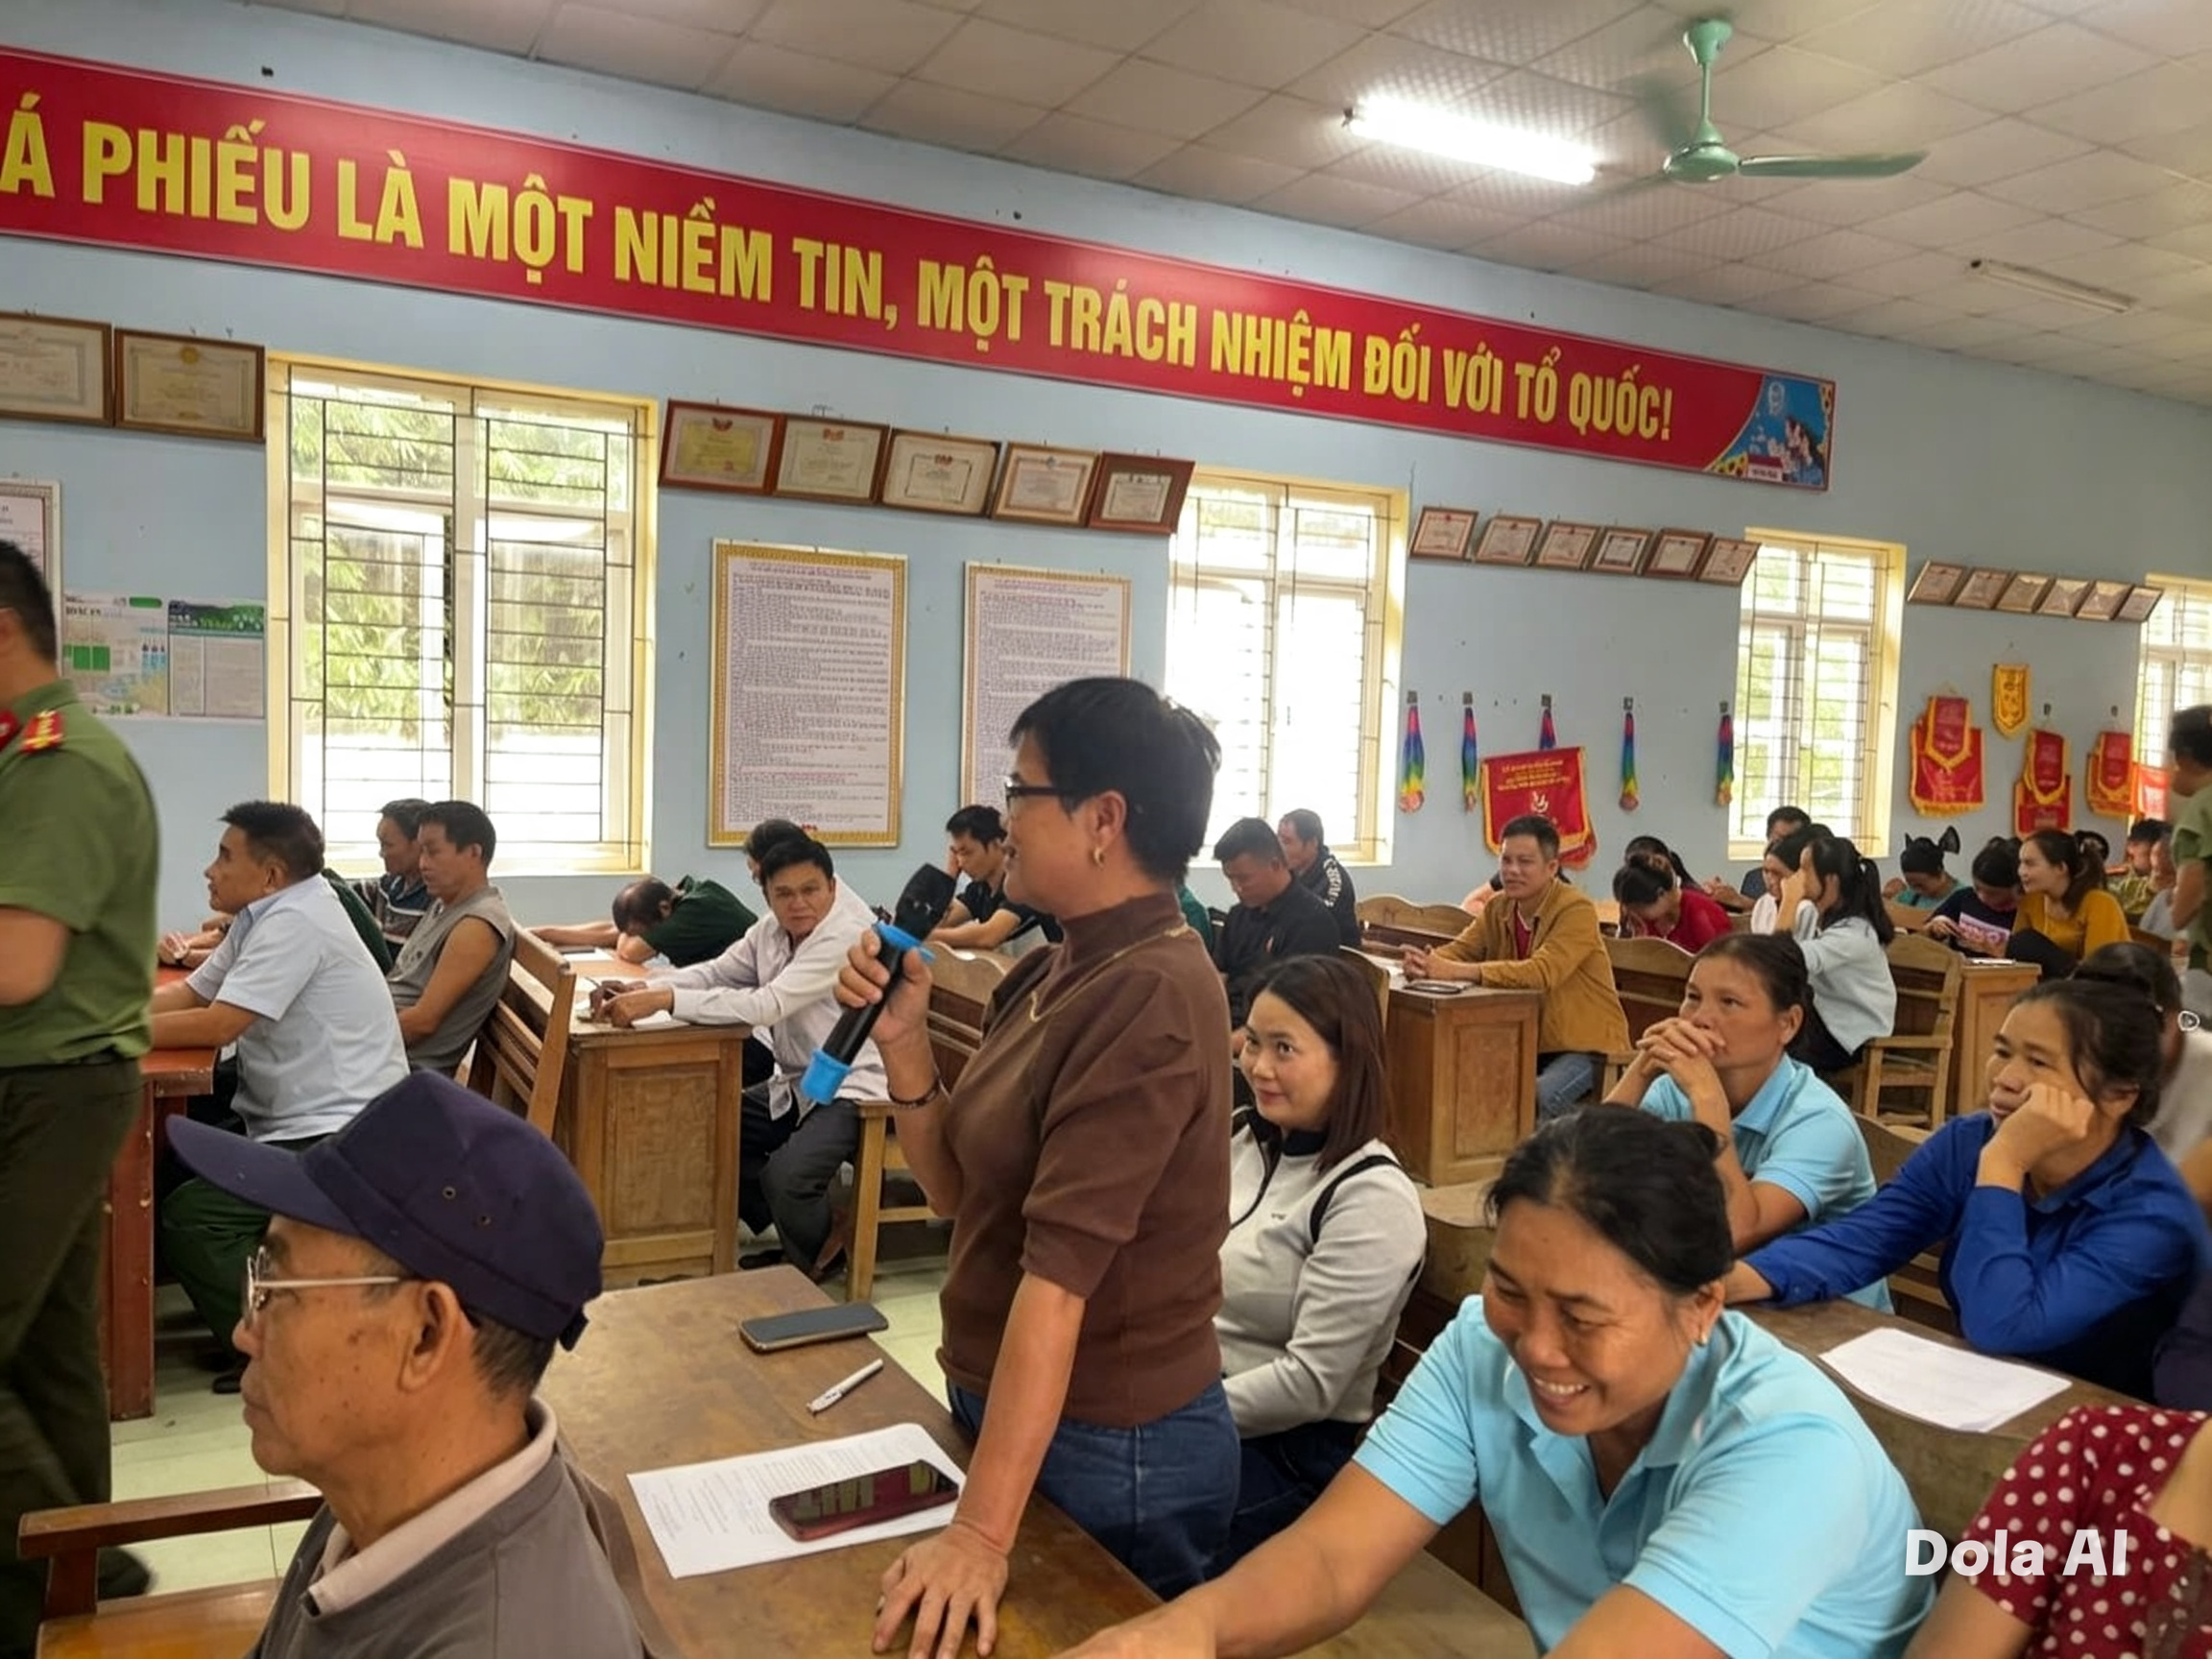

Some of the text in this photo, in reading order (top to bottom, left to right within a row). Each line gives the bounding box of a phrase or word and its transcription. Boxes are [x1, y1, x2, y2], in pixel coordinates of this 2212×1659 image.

[83, 119, 311, 231] PHIẾU
[337, 149, 423, 250] LÀ
[448, 173, 593, 284] MỘT
[614, 196, 773, 302] NIỀM
[793, 237, 898, 330] TIN,
[918, 254, 1028, 351] MỘT
[1045, 278, 1197, 368] TRÁCH
[1212, 309, 1351, 397] NHIỆM
[1363, 322, 1431, 402] ĐỐI
[1443, 343, 1503, 415] VỚI
[1514, 346, 1561, 423] TỔ
[1568, 364, 1672, 442] QUỐC!
